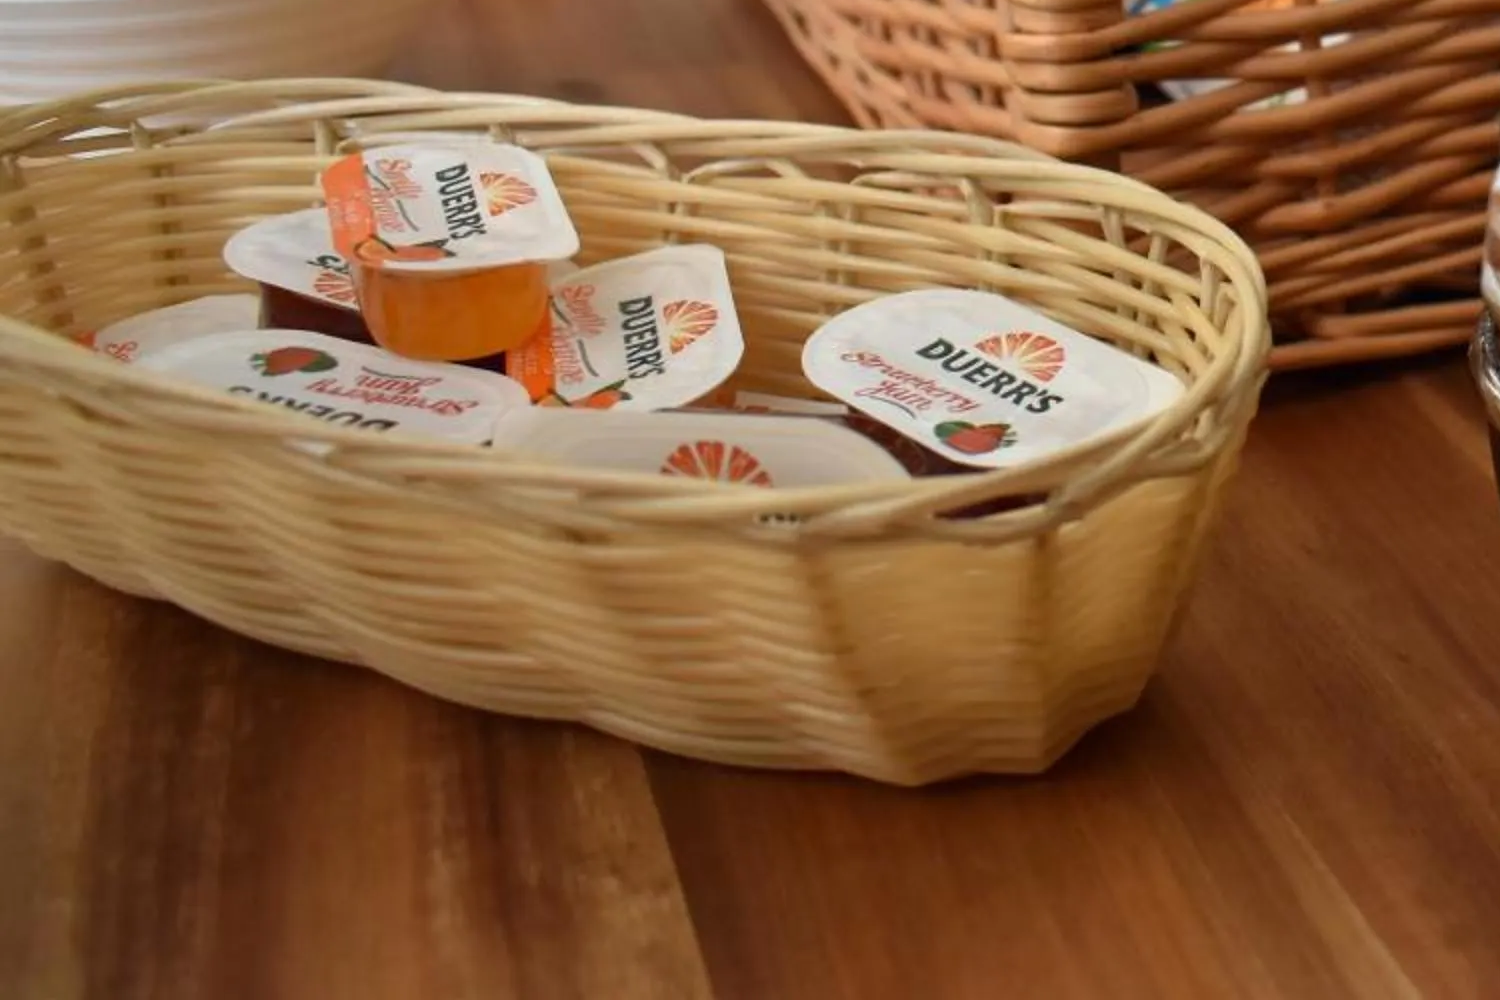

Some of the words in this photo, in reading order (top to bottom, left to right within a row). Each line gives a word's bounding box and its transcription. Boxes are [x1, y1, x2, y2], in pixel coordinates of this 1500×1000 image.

[435, 162, 487, 241] DUERR'S
[618, 295, 667, 381] DUERR'S
[915, 336, 1065, 414] DUERR'S
